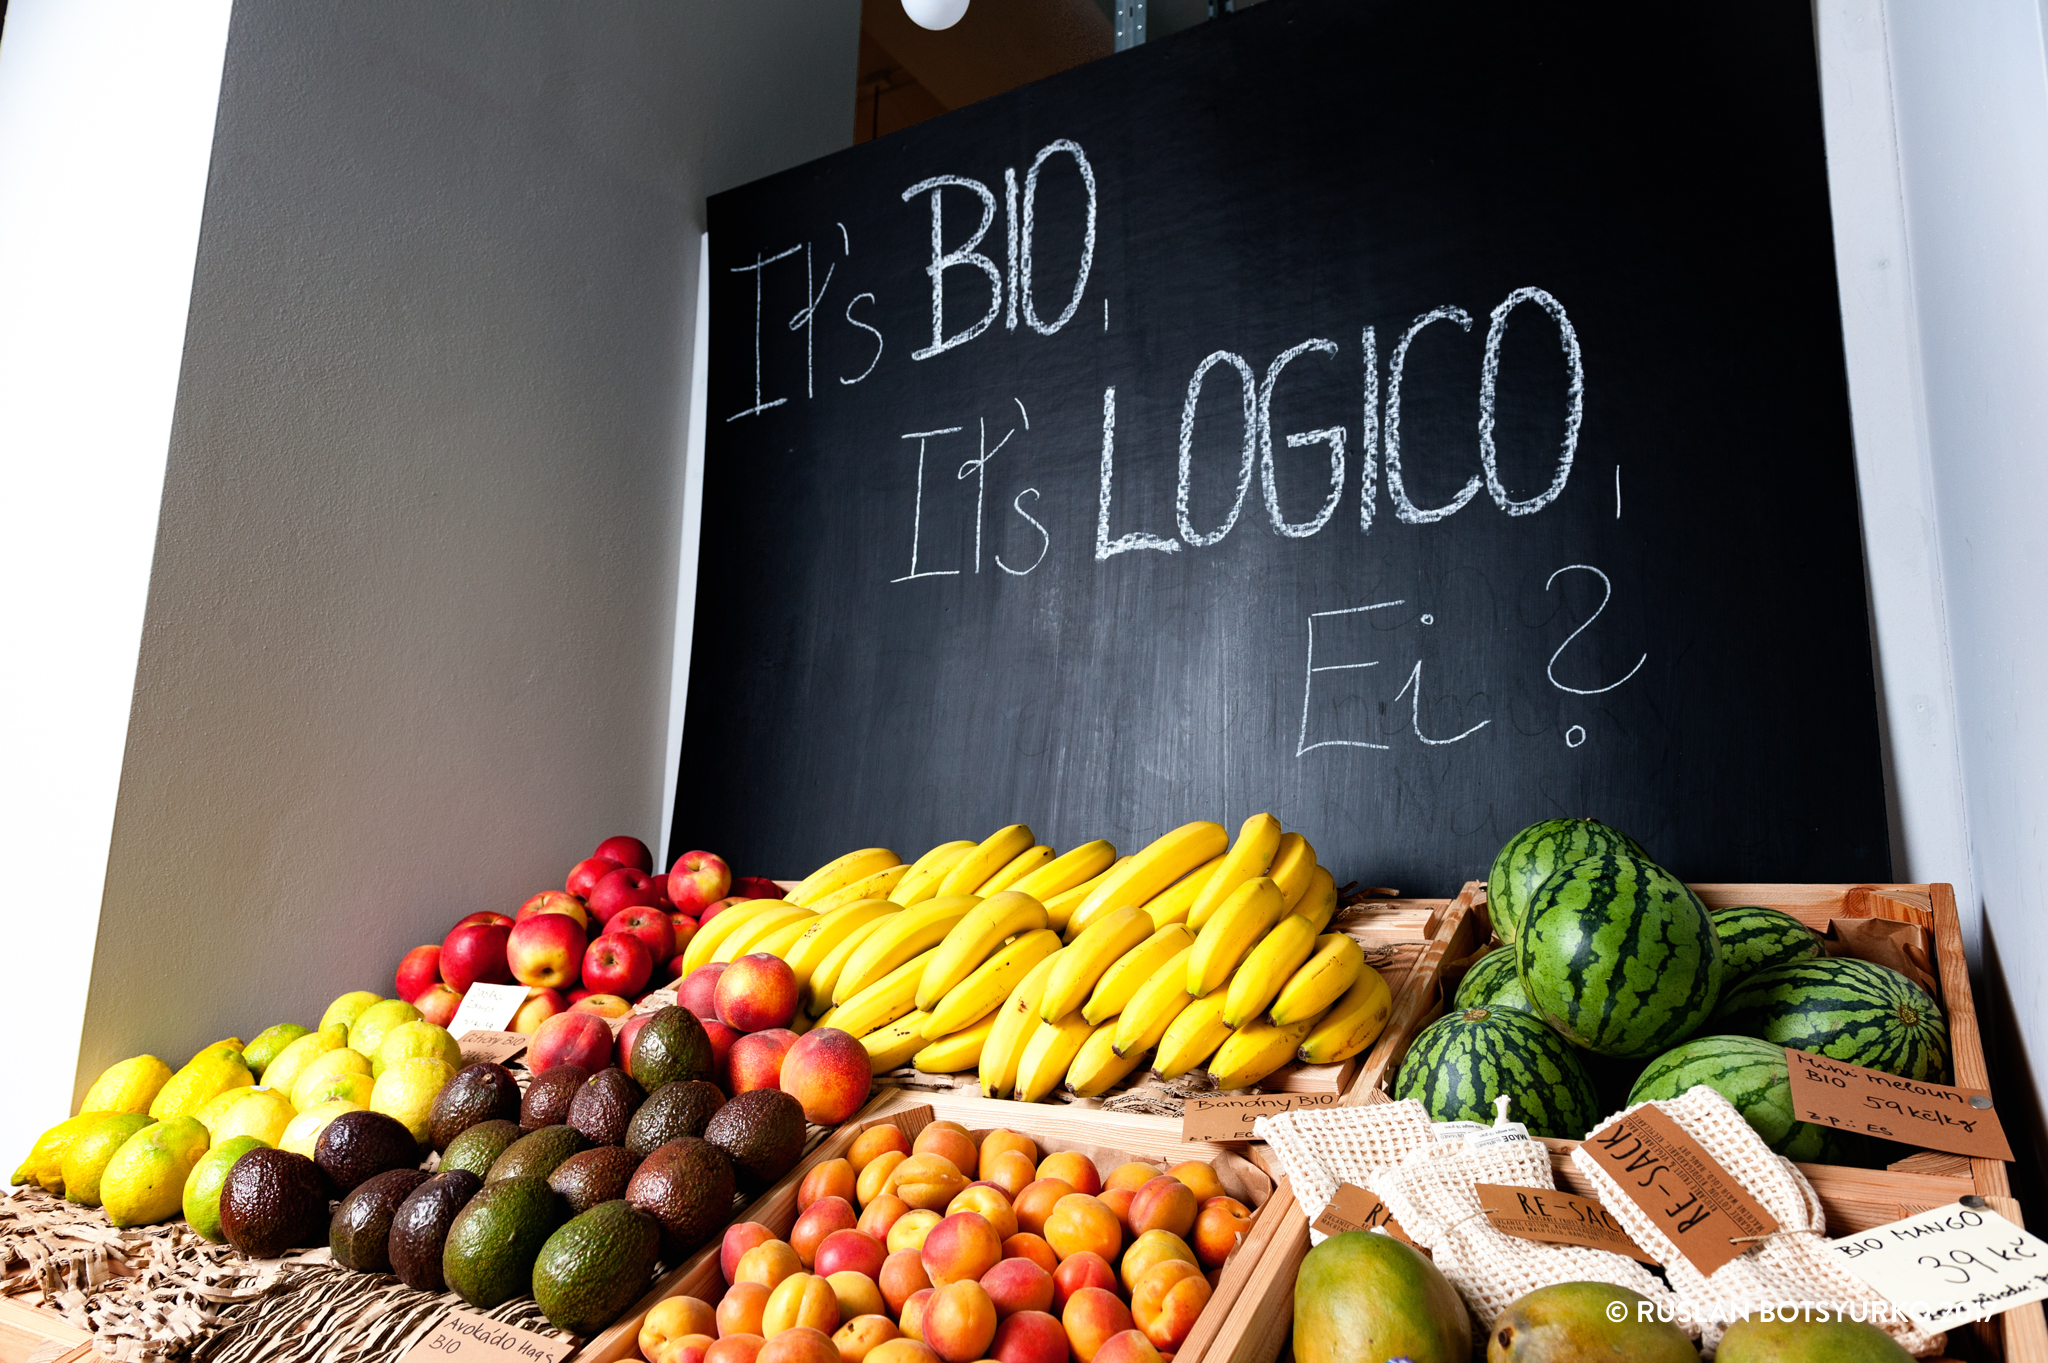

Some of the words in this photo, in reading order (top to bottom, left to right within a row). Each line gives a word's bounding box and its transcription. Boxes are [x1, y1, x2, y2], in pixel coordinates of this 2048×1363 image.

[727, 222, 883, 423] It's
[891, 398, 1049, 583] It's
[1805, 1069, 1846, 1088] BIO
[1193, 1097, 1292, 1112] Banány
[1295, 1094, 1334, 1107] BIO
[1622, 1119, 1640, 1134] BAGS
[1636, 1131, 1670, 1162] VEGETABLES
[1678, 1145, 1692, 1157] DRY
[1691, 1155, 1707, 1173] HANG
[1720, 1188, 1739, 1206] WASH
[1516, 1192, 1626, 1235] RE-SAC
[1729, 1210, 1758, 1237] ORGANIC
[1736, 1203, 1766, 1232] MACHINE
[1834, 1238, 1883, 1259] BIO
[1890, 1210, 1983, 1241] MANGO
[428, 1334, 462, 1354] BIO
[443, 1317, 517, 1351] Avokádo
